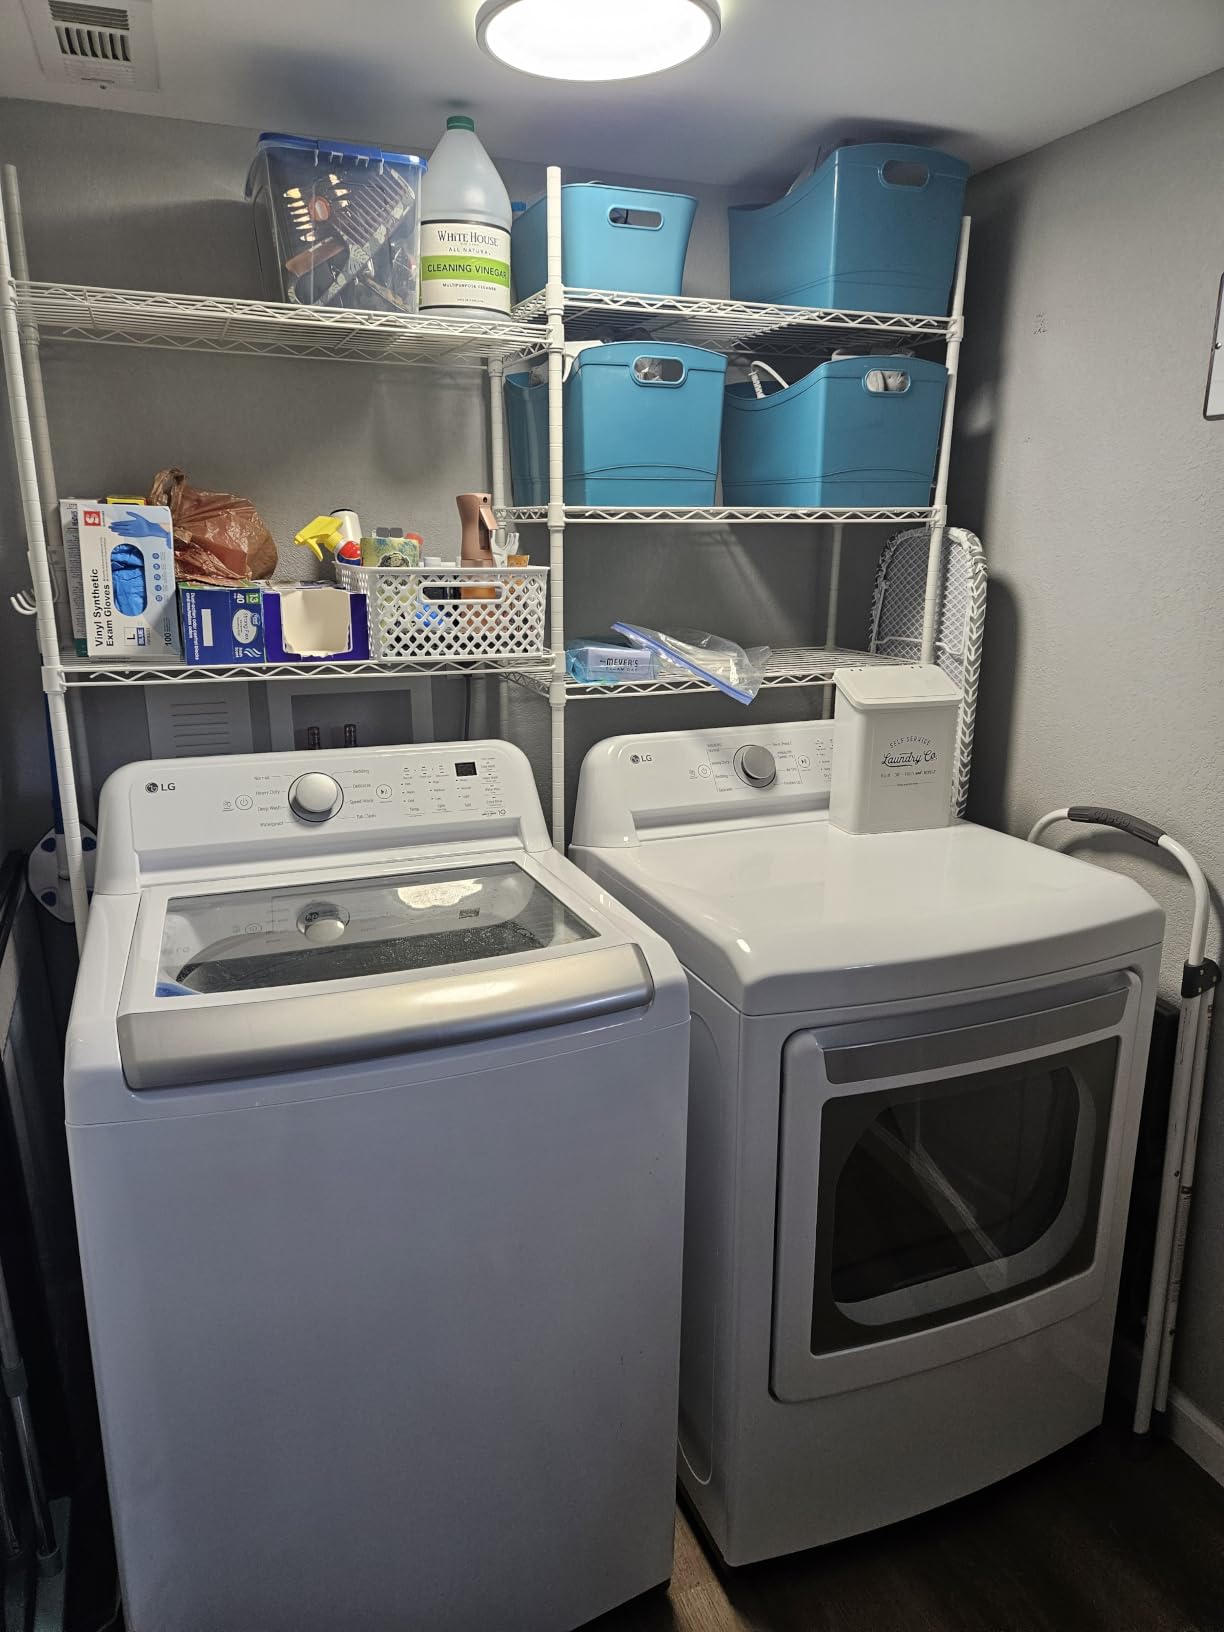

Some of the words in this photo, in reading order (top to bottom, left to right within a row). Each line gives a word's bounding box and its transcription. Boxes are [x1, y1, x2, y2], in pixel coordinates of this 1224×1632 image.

[470, 231, 499, 247] HOUSE
[427, 263, 472, 273] CLEANING
[474, 265, 507, 279] VINEGAR
[89, 568, 103, 618] Synthetic
[103, 584, 112, 617] Gloves
[236, 593, 245, 604] 40
[249, 593, 259, 603] 13
[95, 620, 103, 647] Vinyl
[104, 620, 114, 647] Exam
[164, 632, 172, 646] 100
[641, 754, 653, 762] LG
[881, 751, 922, 767] Laundry
[160, 782, 176, 792] LG
